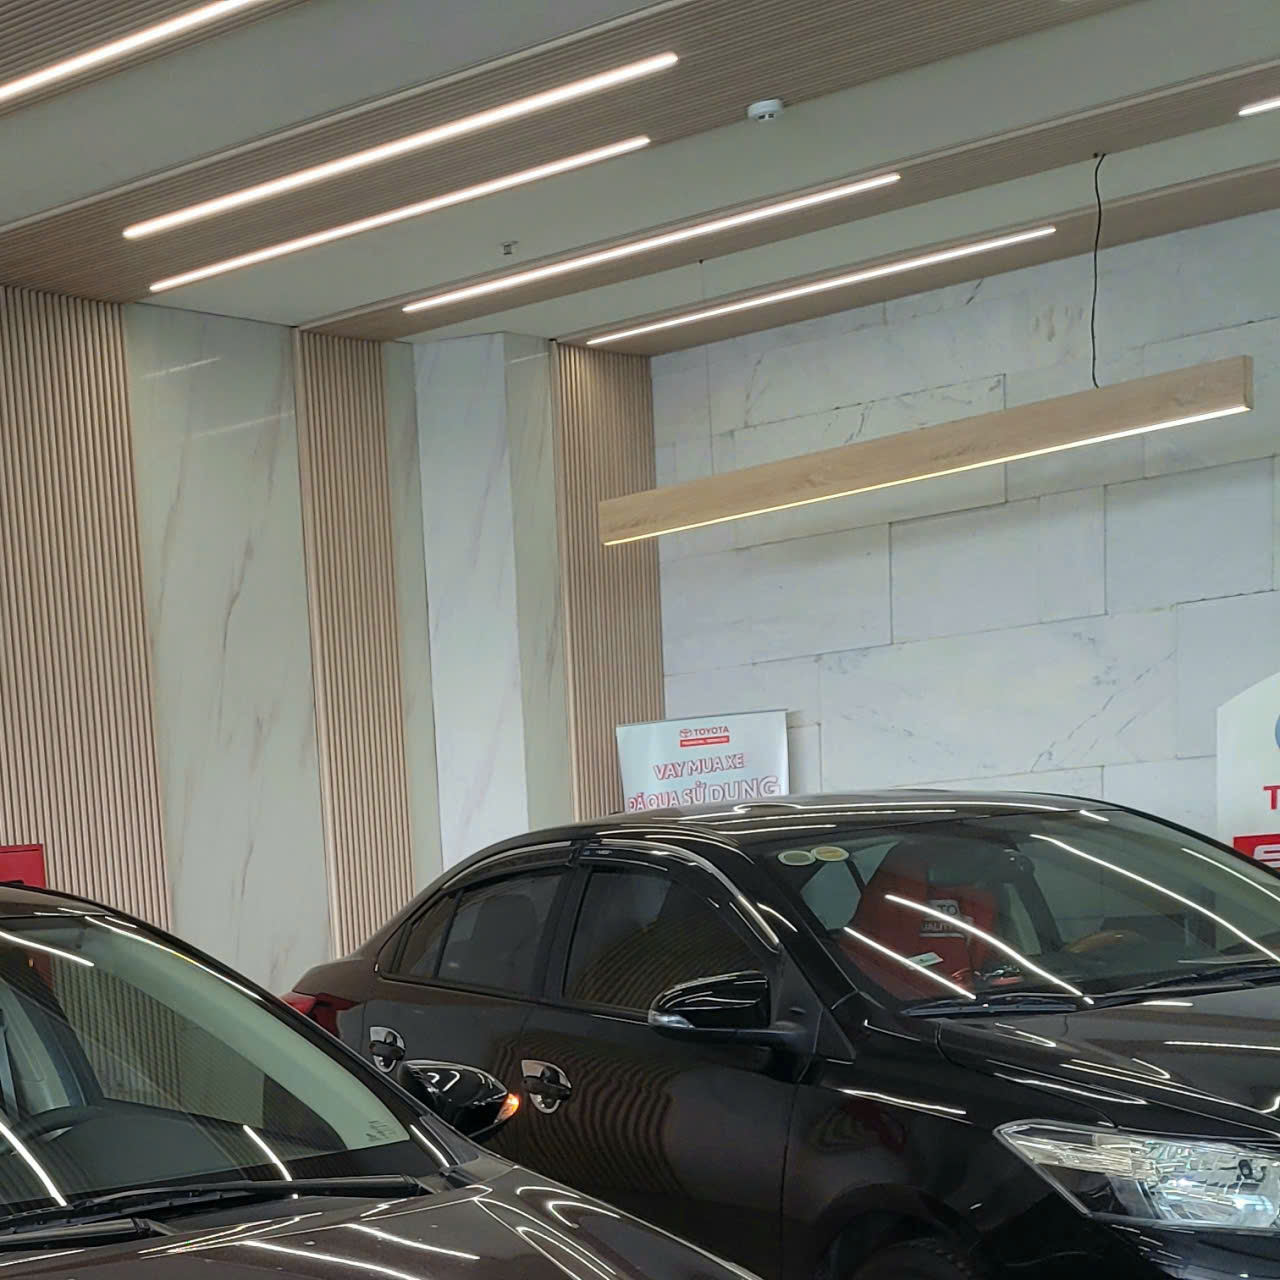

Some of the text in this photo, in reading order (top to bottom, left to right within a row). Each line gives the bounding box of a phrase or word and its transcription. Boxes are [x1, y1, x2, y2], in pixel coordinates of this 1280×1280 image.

[693, 726, 730, 736] TOYOTA
[654, 753, 745, 780] VAY MUA XE
[647, 791, 681, 809] QUA
